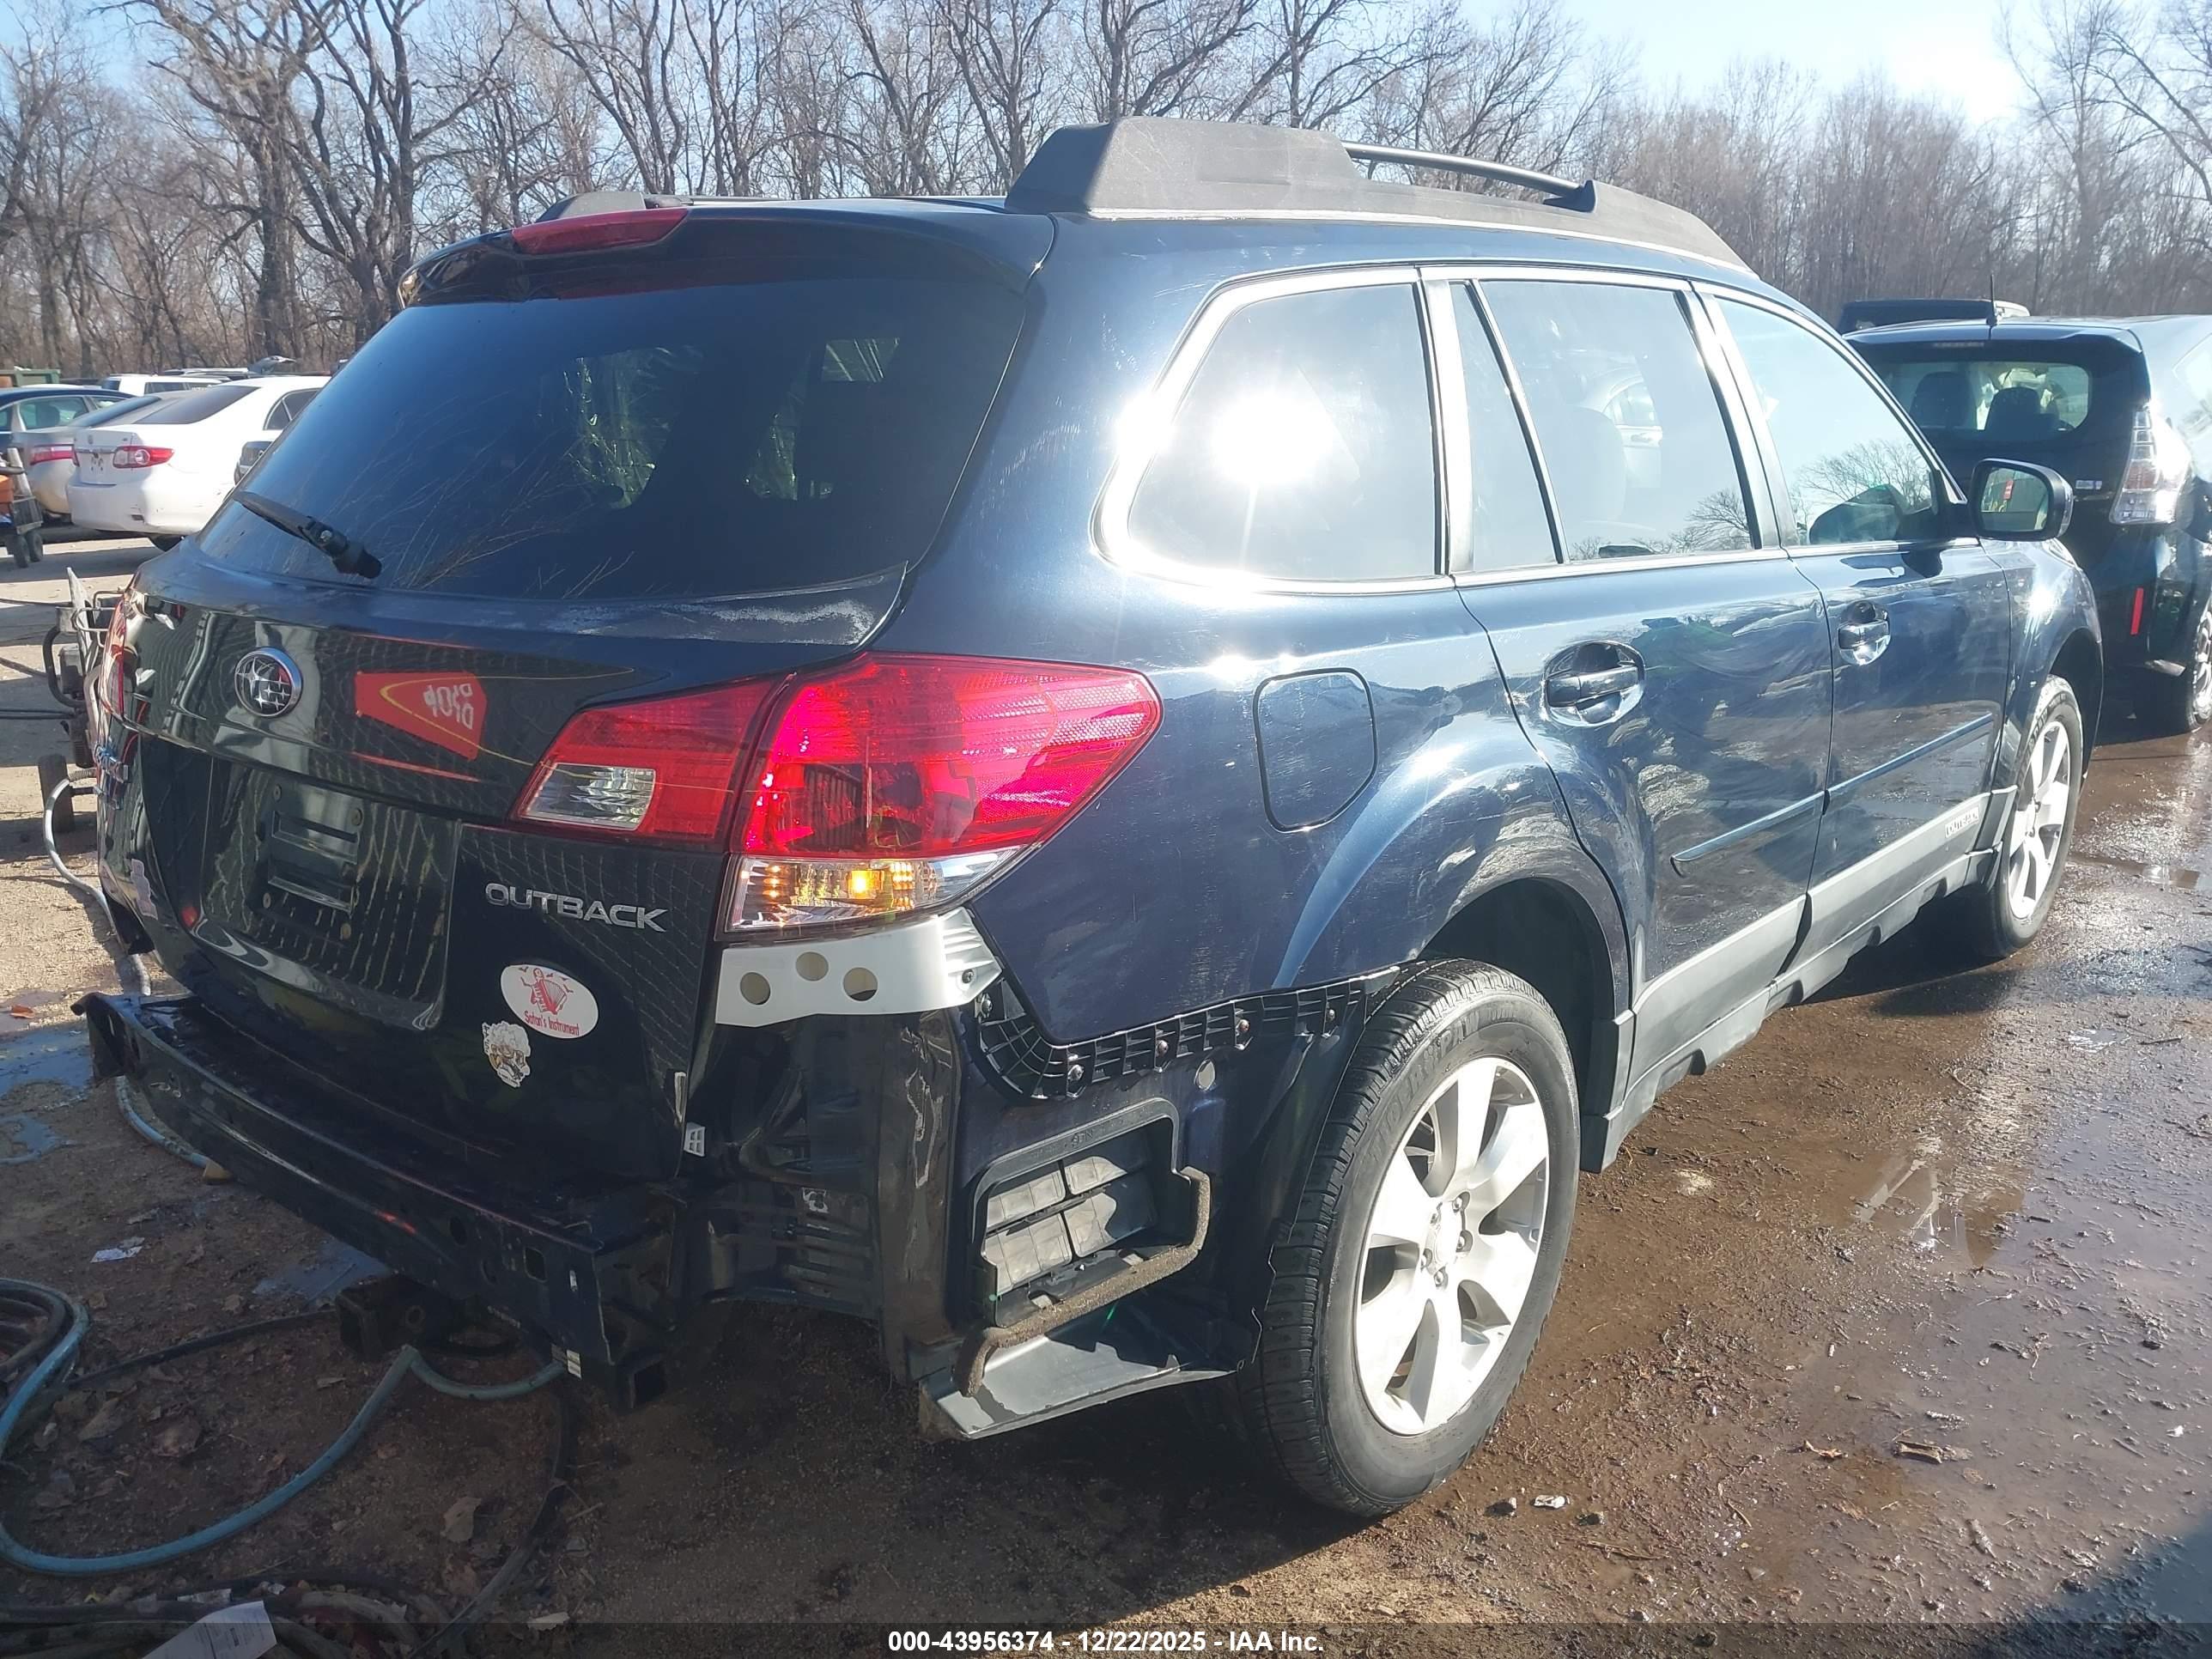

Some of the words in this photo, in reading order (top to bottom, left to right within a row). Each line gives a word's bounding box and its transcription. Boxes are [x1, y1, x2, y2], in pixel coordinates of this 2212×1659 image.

[485, 883, 669, 933] OUTBACK
[524, 1010, 546, 1028] Satan's
[548, 1017, 580, 1036] Instrument
